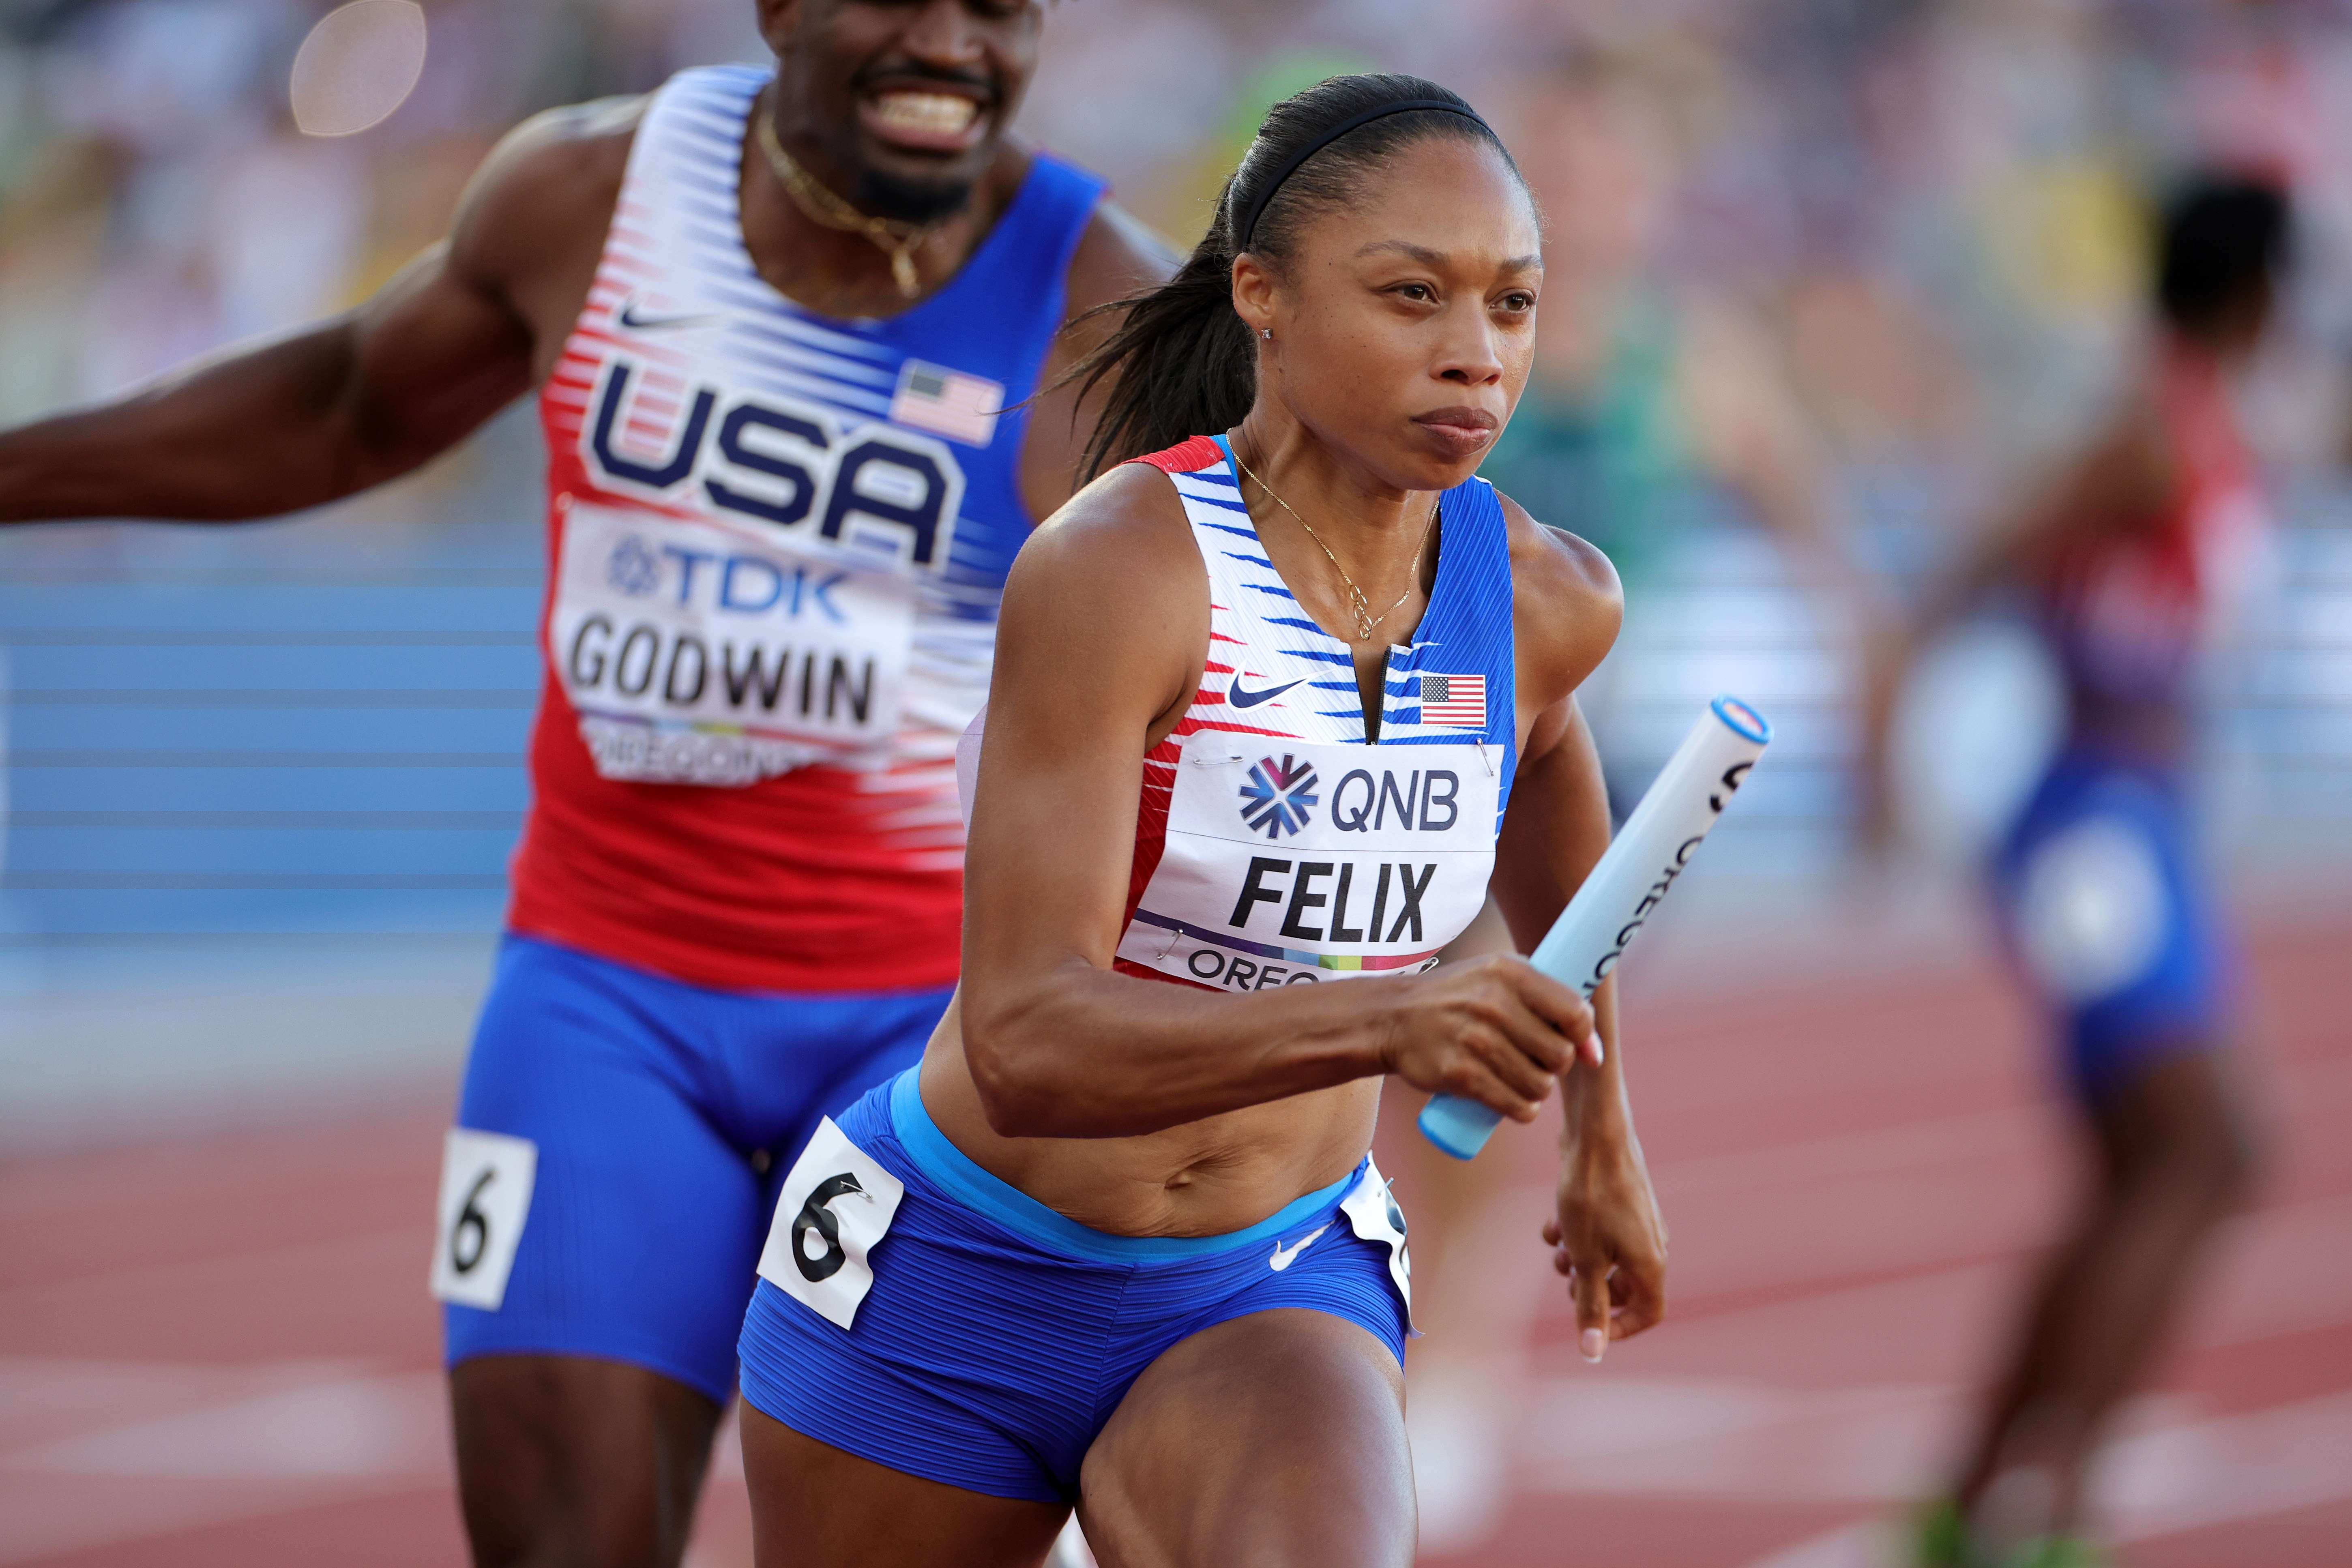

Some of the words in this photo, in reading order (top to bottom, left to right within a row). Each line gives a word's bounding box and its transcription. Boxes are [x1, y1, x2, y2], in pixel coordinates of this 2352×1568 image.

[593, 362, 946, 564] USA
[661, 543, 858, 625] TDK
[569, 615, 878, 724] GODWIN
[1331, 768, 1459, 833] QNB
[1228, 856, 1438, 943] FELIX
[451, 1167, 500, 1274] 6
[791, 1171, 865, 1283] 6
